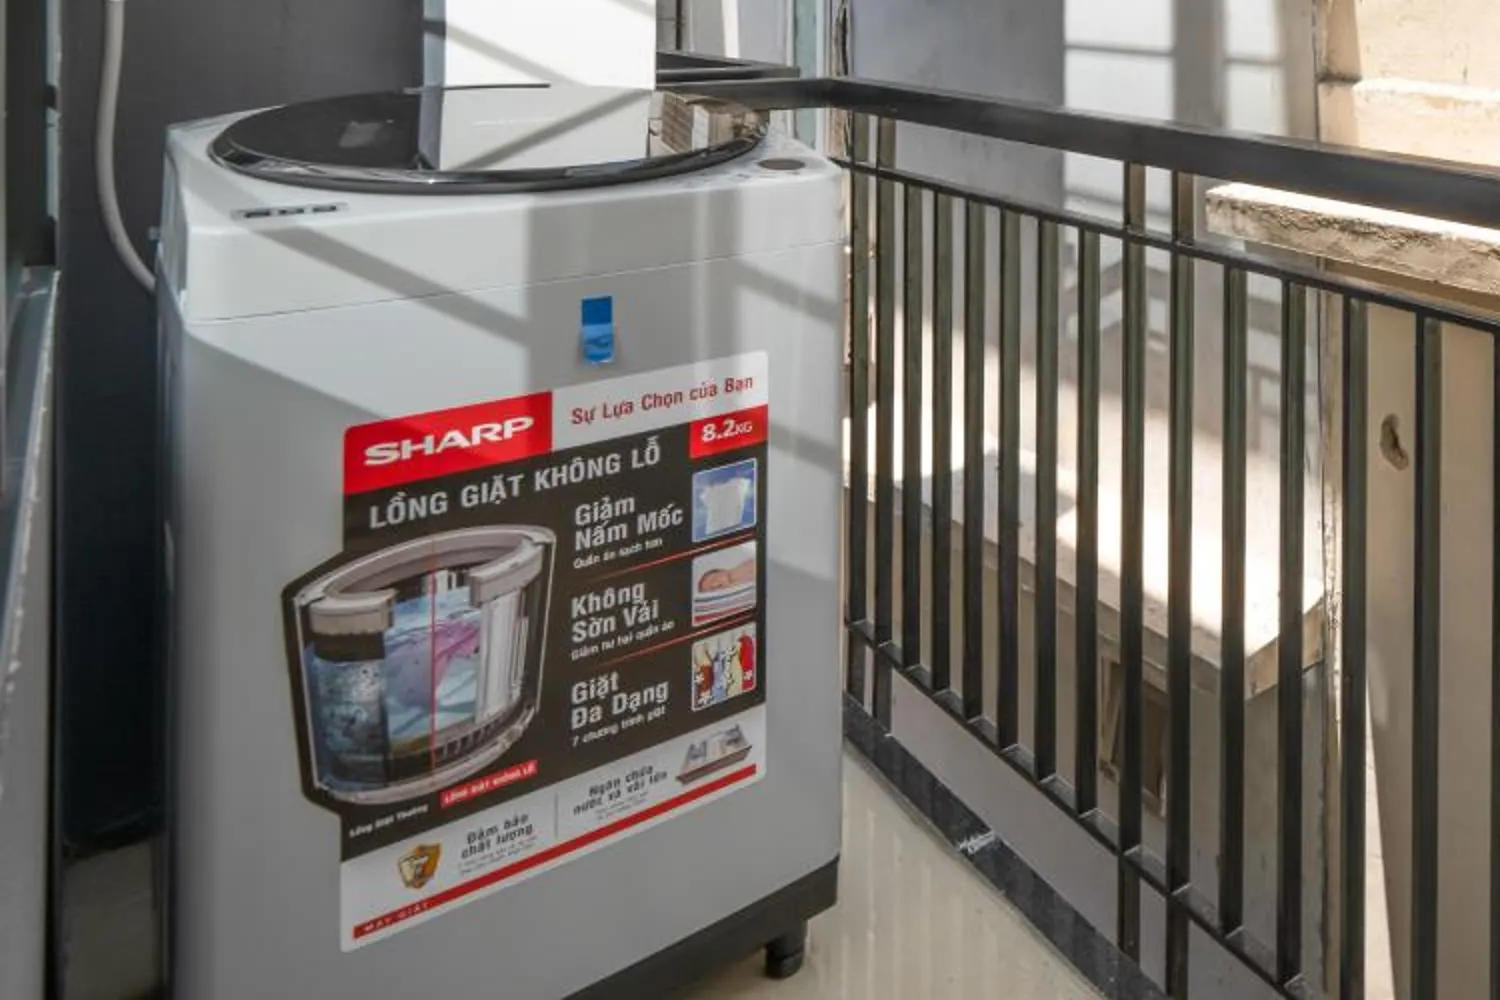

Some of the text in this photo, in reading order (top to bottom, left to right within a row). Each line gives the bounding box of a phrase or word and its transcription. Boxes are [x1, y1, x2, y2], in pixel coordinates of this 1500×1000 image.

[364, 416, 534, 466] SHARP
[369, 490, 448, 530] LỒNG
[461, 472, 524, 508] GIẶT
[534, 452, 621, 493] KHÔNG
[574, 496, 636, 526] Giảm
[574, 503, 684, 551] Nấm Mốc
[571, 583, 646, 619] Không
[571, 599, 660, 643] Sờn Vải
[571, 670, 620, 705] Giặt
[571, 680, 669, 731] Đa Dạng
